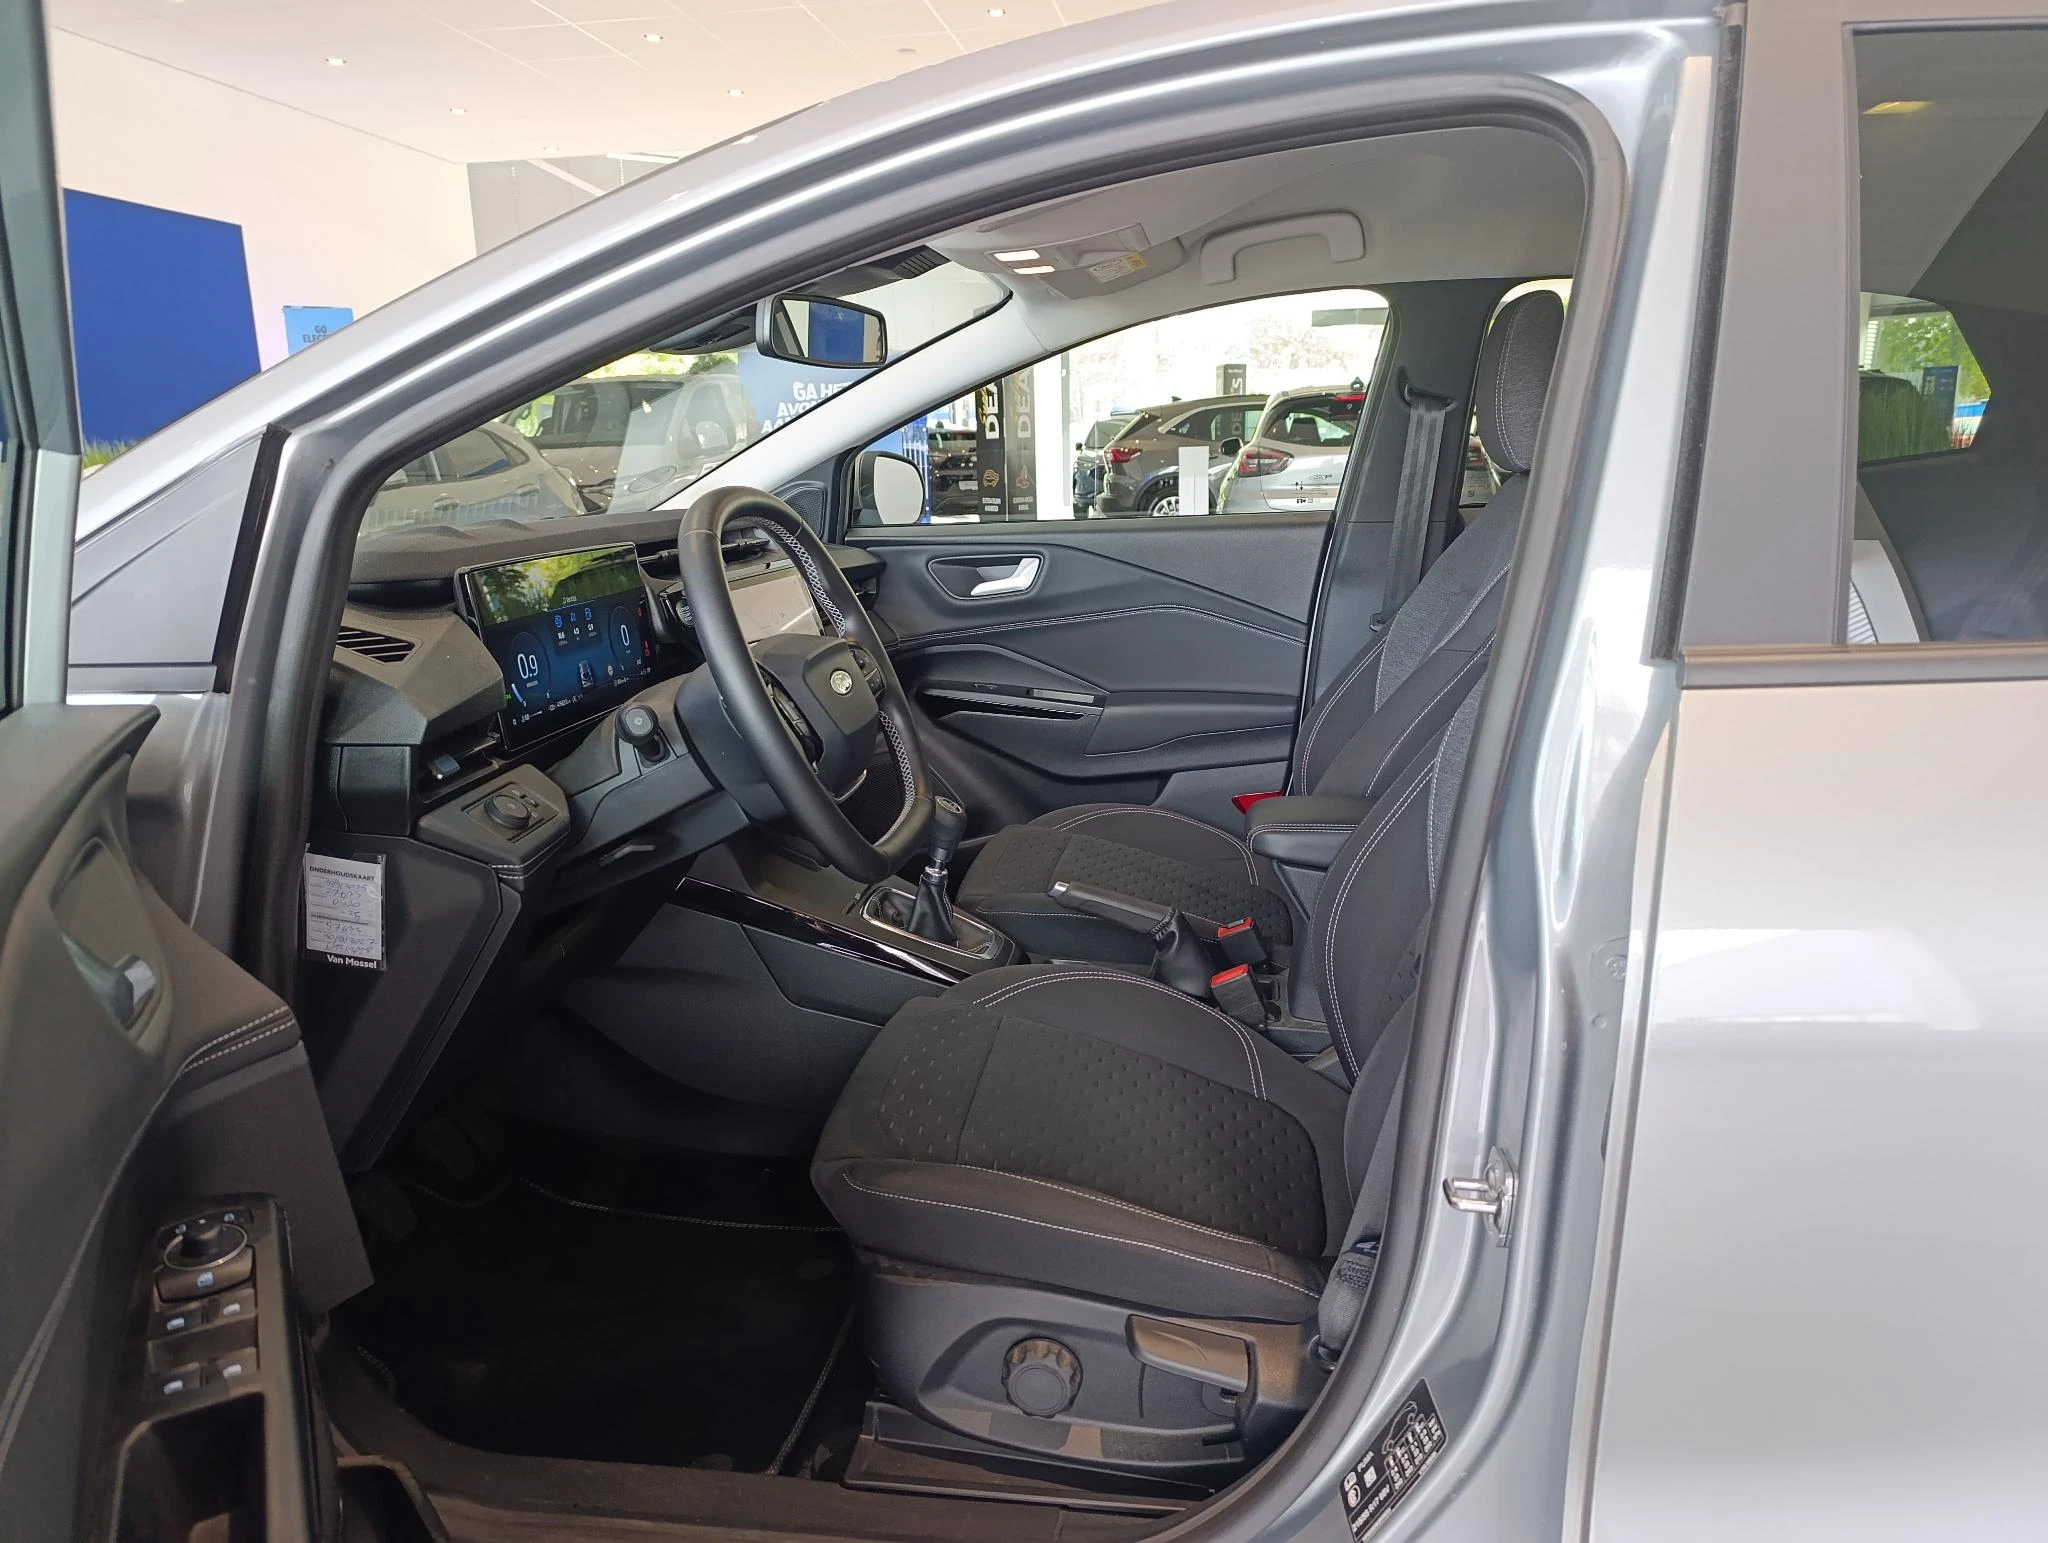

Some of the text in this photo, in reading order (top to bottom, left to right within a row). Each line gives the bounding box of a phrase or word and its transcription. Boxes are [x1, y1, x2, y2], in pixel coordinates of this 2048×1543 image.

[792, 381, 818, 401] GA
[517, 653, 539, 679] 0.9
[309, 866, 376, 881] ONDERHOUDSKAART
[326, 953, 377, 969] Van Mossel
